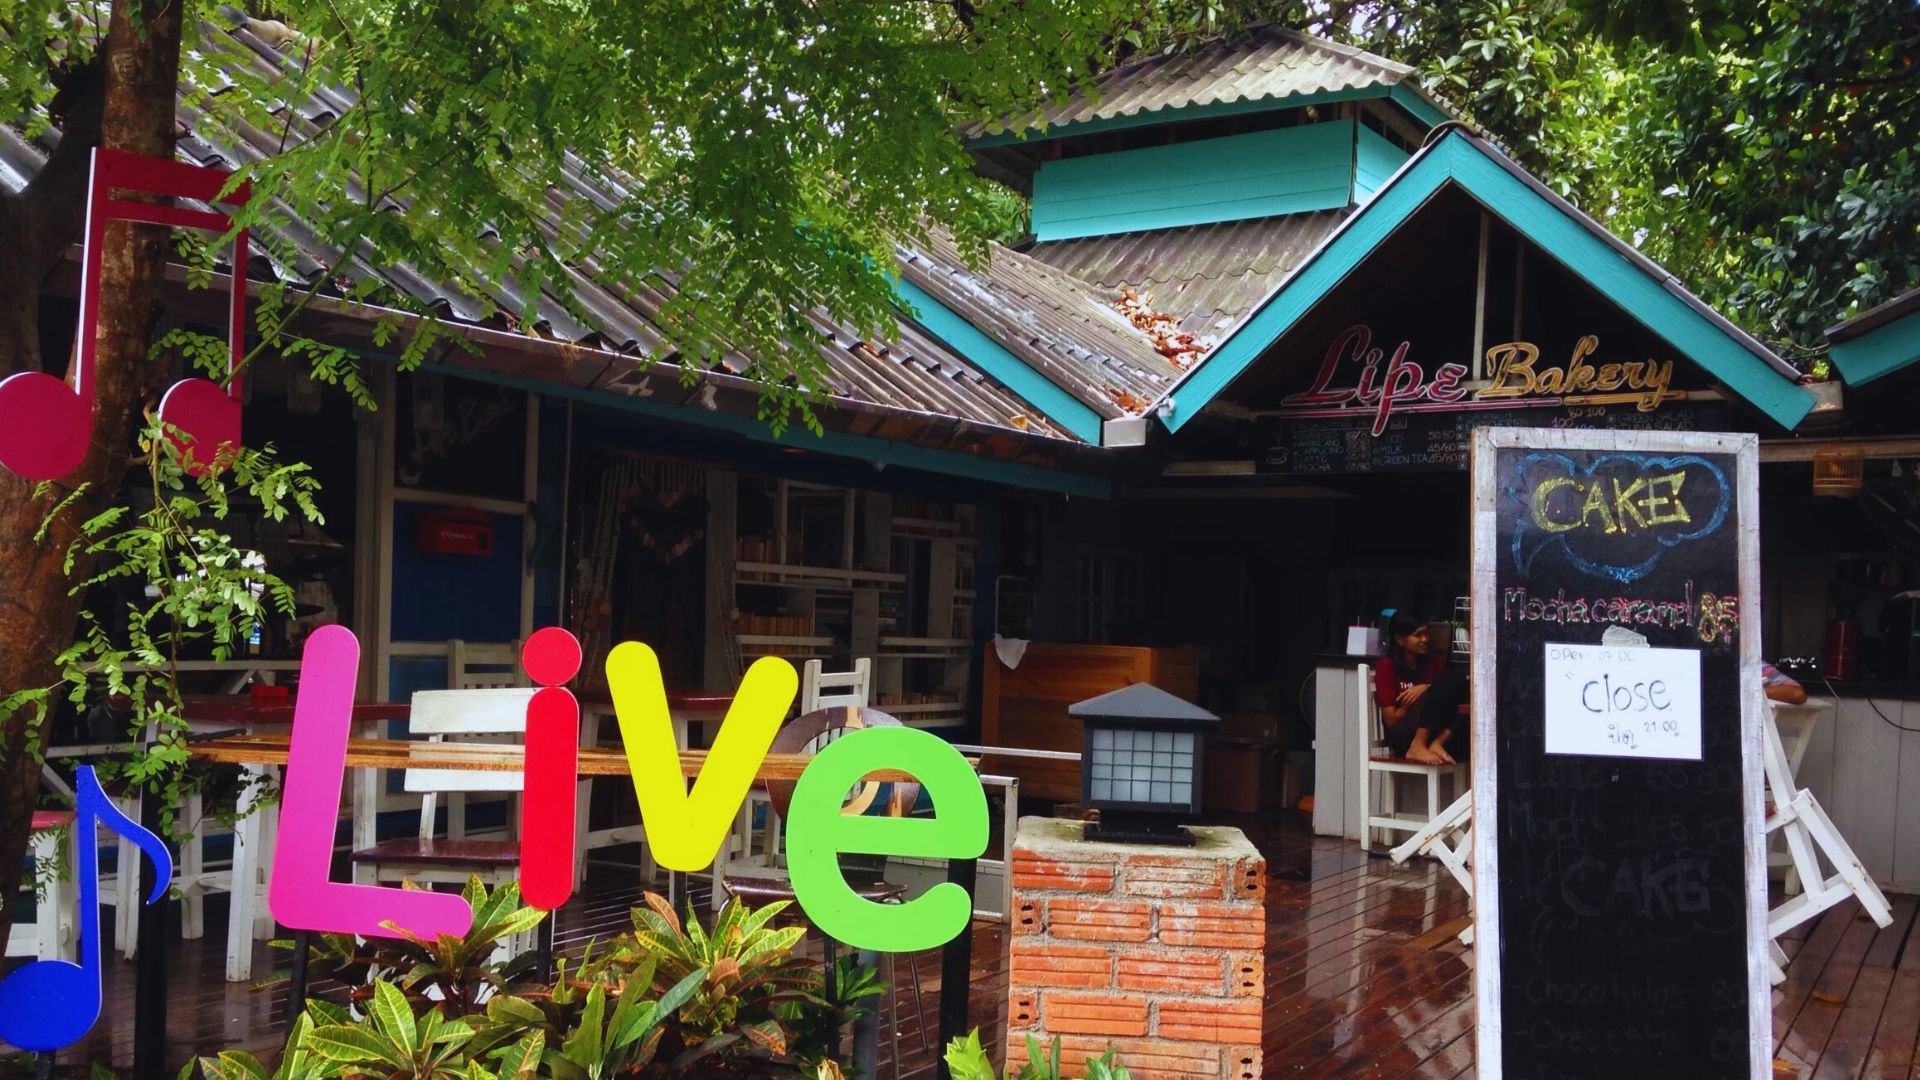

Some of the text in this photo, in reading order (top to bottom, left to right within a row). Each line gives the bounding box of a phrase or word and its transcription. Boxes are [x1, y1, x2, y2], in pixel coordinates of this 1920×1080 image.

[1280, 324, 1674, 438] Lipe Bakery
[1531, 470, 1691, 534] CAKE
[268, 624, 990, 952] Live
[1560, 856, 1711, 919] CAKE
